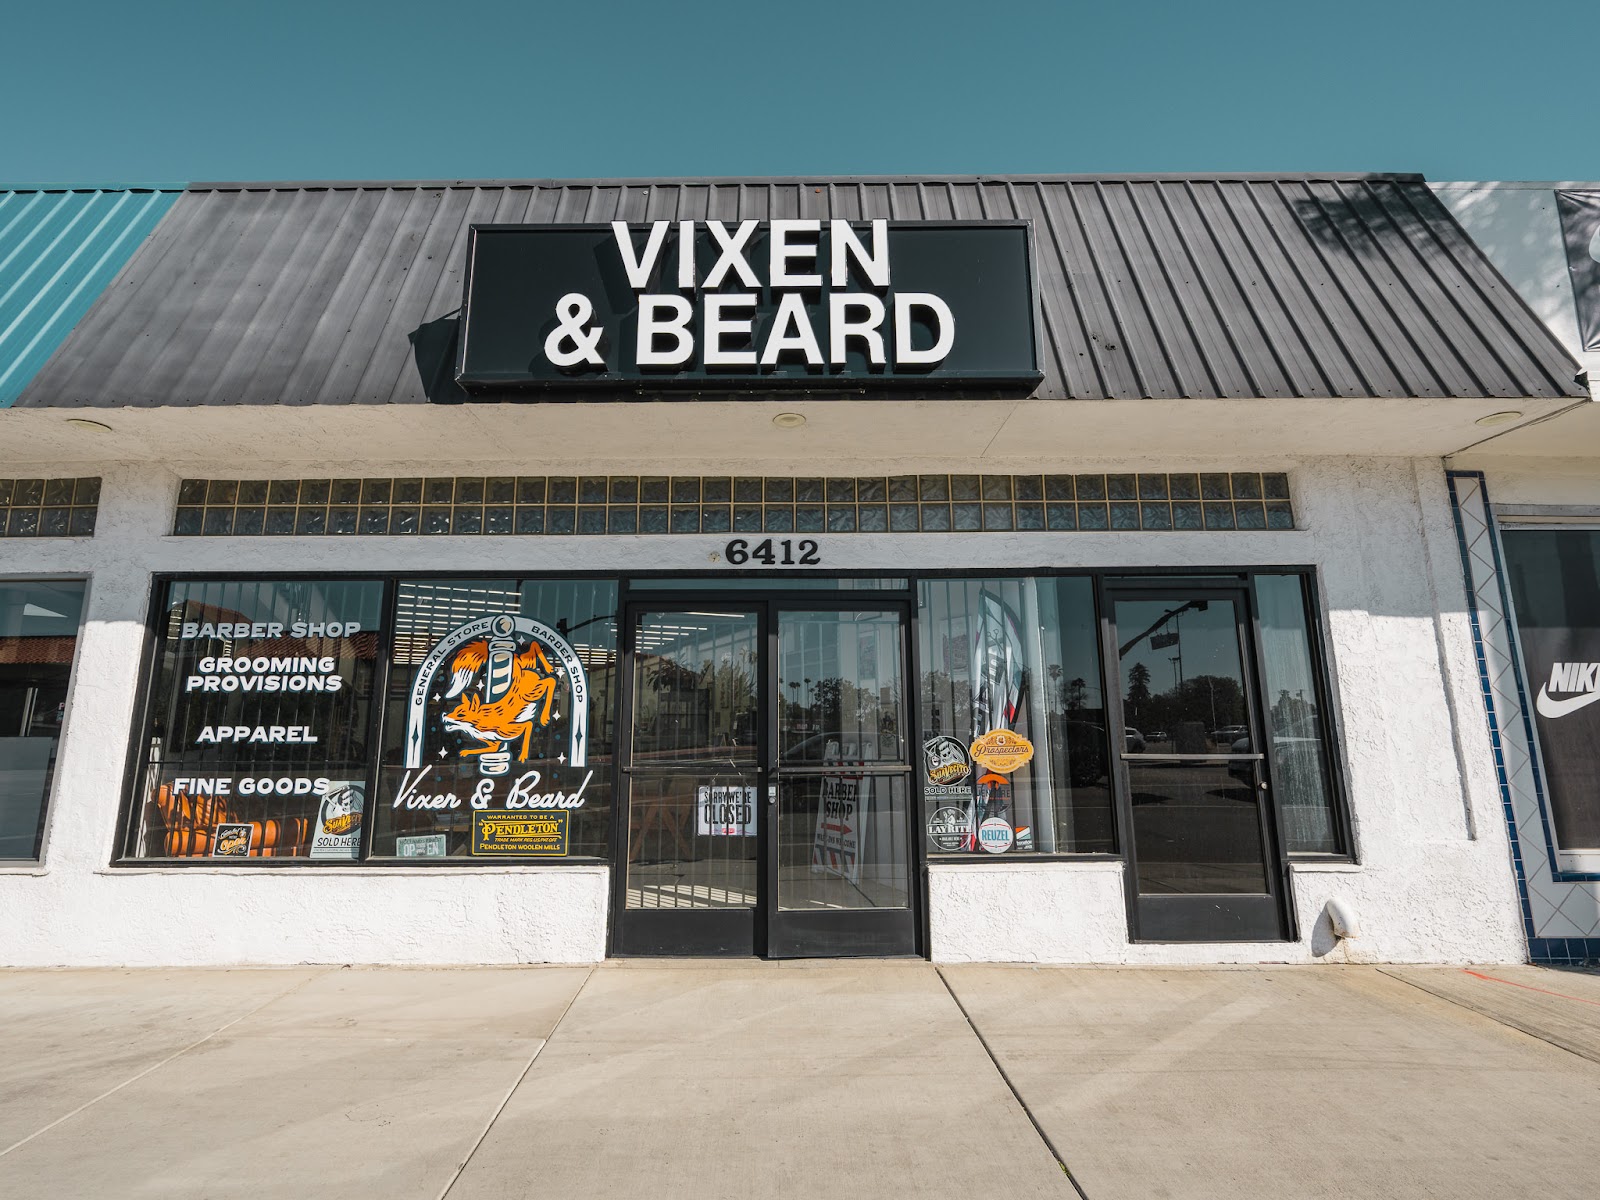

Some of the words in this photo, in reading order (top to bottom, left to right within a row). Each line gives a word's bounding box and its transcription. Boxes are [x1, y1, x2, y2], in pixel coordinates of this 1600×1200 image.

[611, 219, 890, 288] VIXEN
[544, 292, 605, 366] &
[636, 292, 955, 366] BEARD
[725, 538, 821, 566] 6412
[181, 621, 284, 640] BARBER
[289, 621, 361, 639] SHOP
[199, 656, 335, 674] GROOMING
[415, 646, 446, 706] GENERAL
[447, 620, 489, 647] STORE
[531, 624, 573, 664] BARBER
[569, 665, 584, 703] SHOP
[185, 674, 343, 693] PROVISIONS
[1548, 662, 1600, 693] NIK
[195, 726, 319, 744] APPAREL
[974, 743, 1029, 758] Prospectors
[172, 778, 233, 797] FINE
[237, 778, 331, 797] GOODS
[393, 764, 462, 809] Vixen
[470, 778, 495, 809] &
[505, 770, 594, 809] Beard
[924, 787, 947, 795] SOLD
[948, 786, 972, 794] HERE
[704, 791, 727, 804] SRRY
[704, 803, 752, 824] CLOSED
[826, 800, 853, 821] SHOP
[323, 813, 362, 834] SUAVECIT
[317, 838, 340, 846] SOLD
[340, 837, 361, 846] HERE
[838, 838, 856, 850] WECOME
[981, 829, 1010, 841] REUZEL
